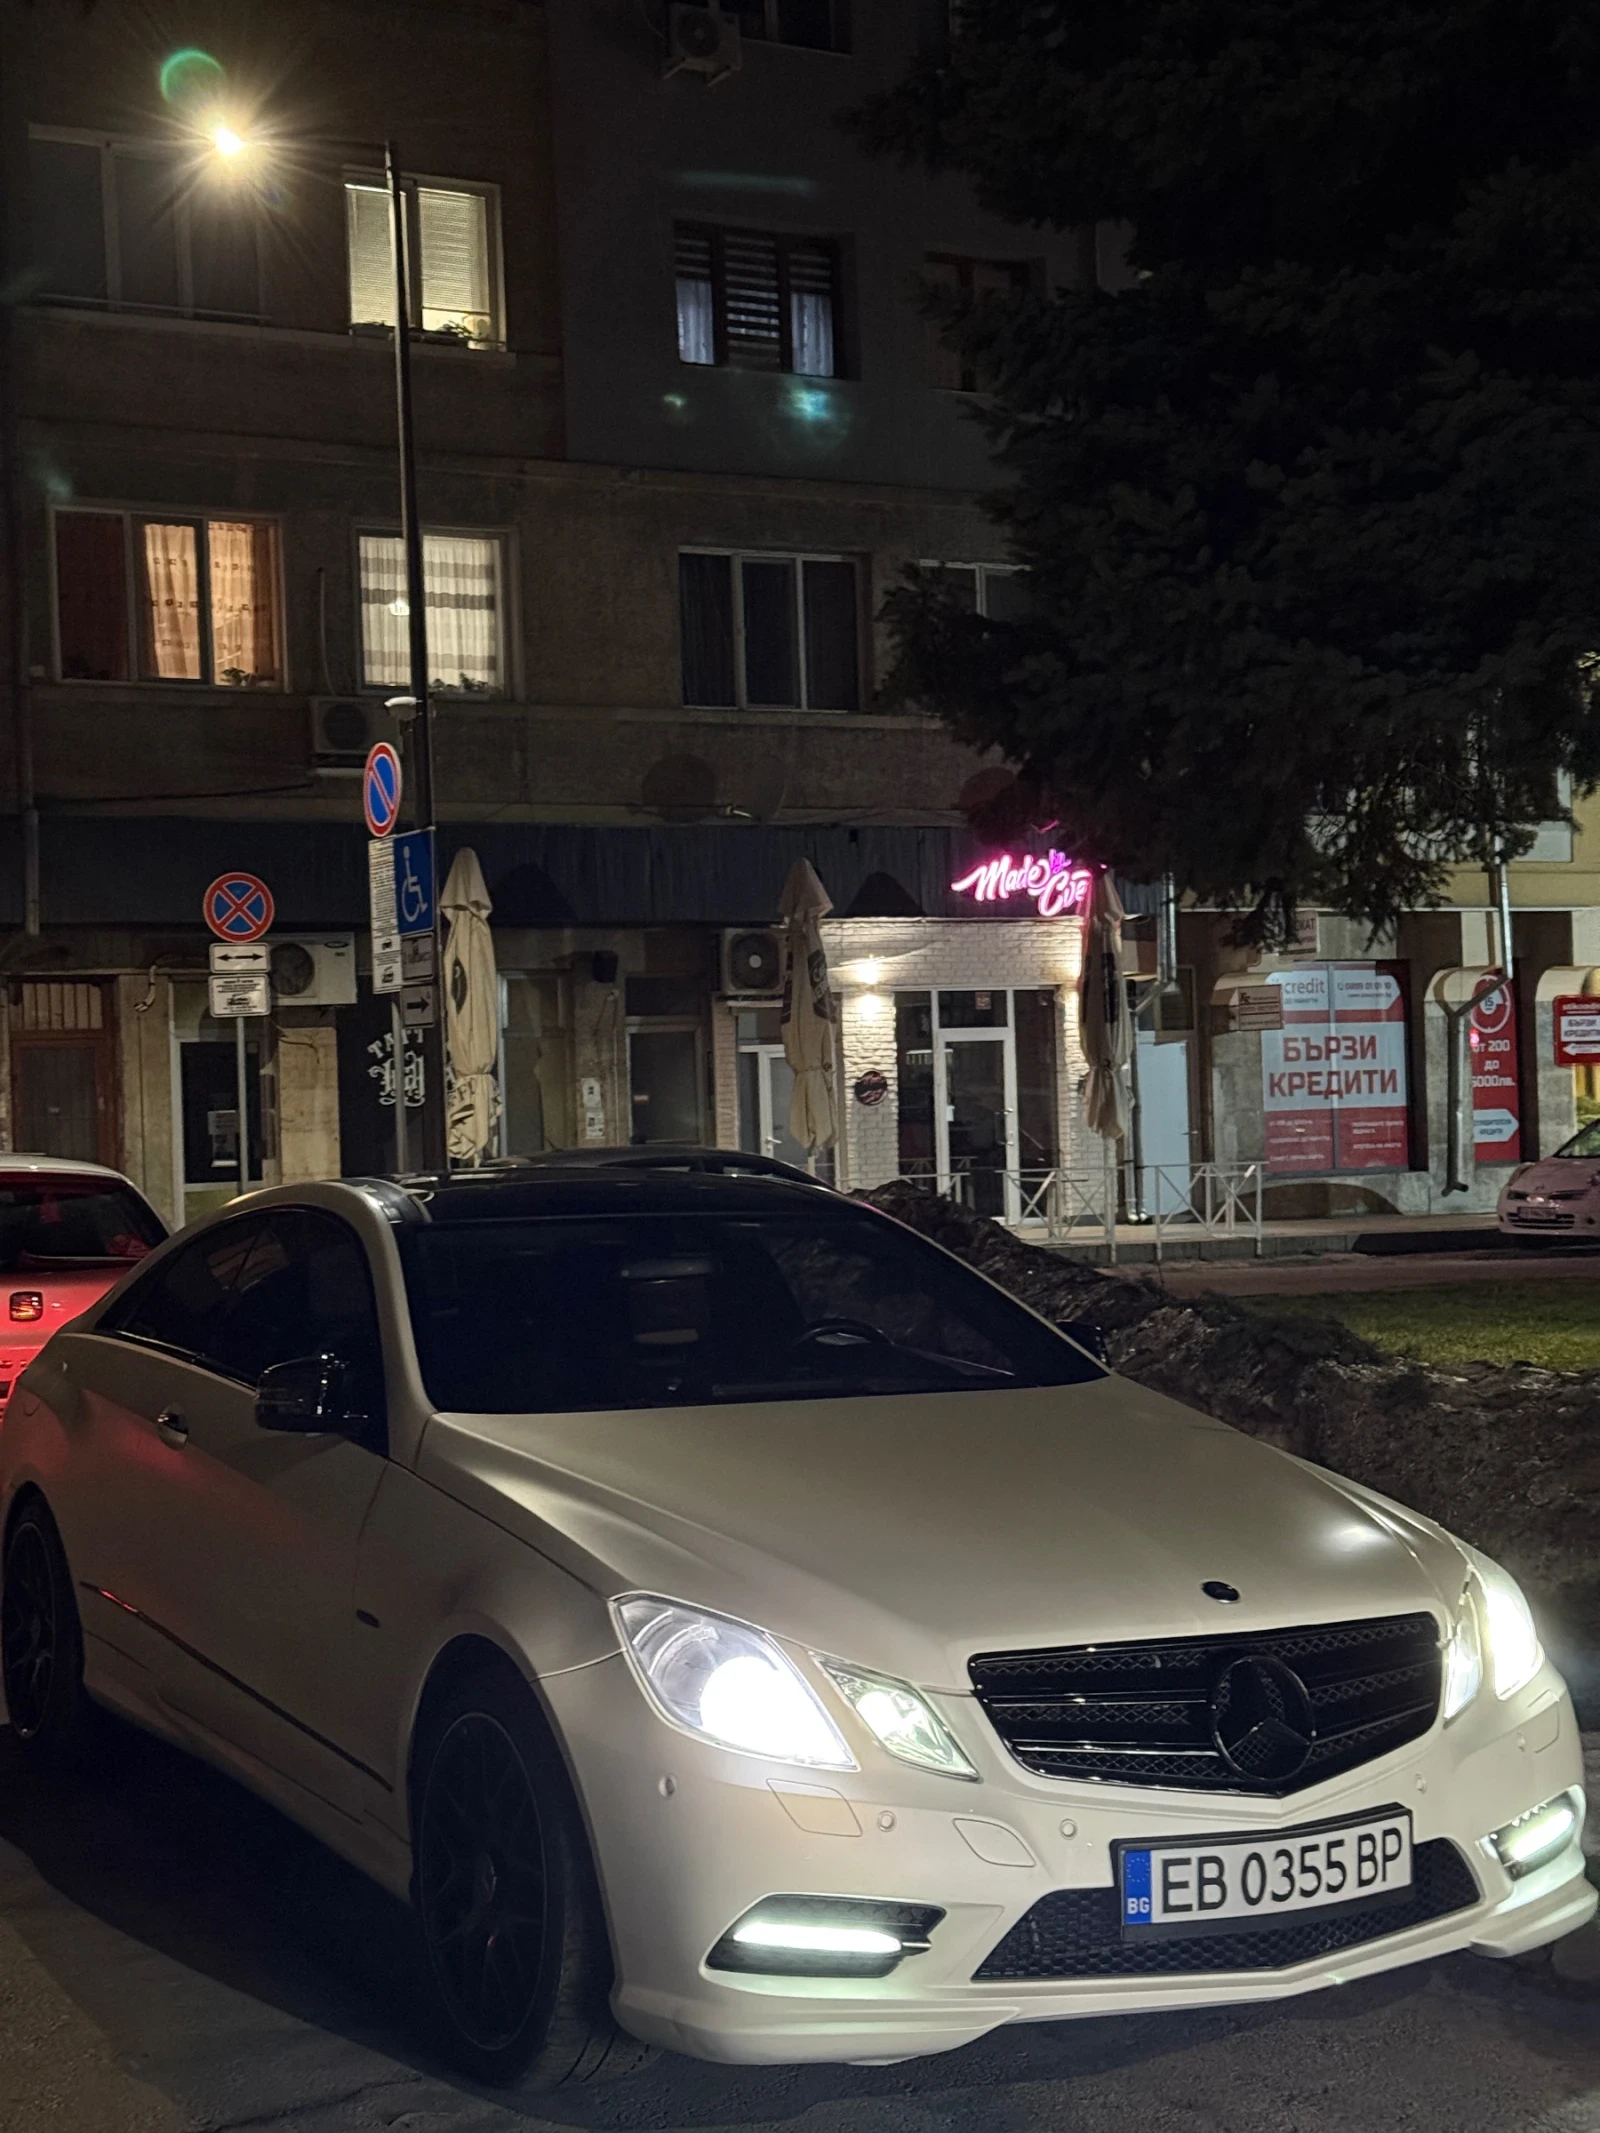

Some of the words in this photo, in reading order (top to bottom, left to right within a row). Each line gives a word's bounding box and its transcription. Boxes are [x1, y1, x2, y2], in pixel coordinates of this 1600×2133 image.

[951, 855, 1050, 901] Made
[1282, 1034, 1378, 1062] БЪРЗИ
[1487, 1039, 1511, 1052] 200
[1483, 1060, 1500, 1072] до
[1269, 1068, 1398, 1101] КРЕДИТИ
[1161, 1855, 1228, 1914] EB
[1240, 1838, 1348, 1907] 0355
[1356, 1827, 1403, 1888] BP
[1126, 1897, 1150, 1914] BG
